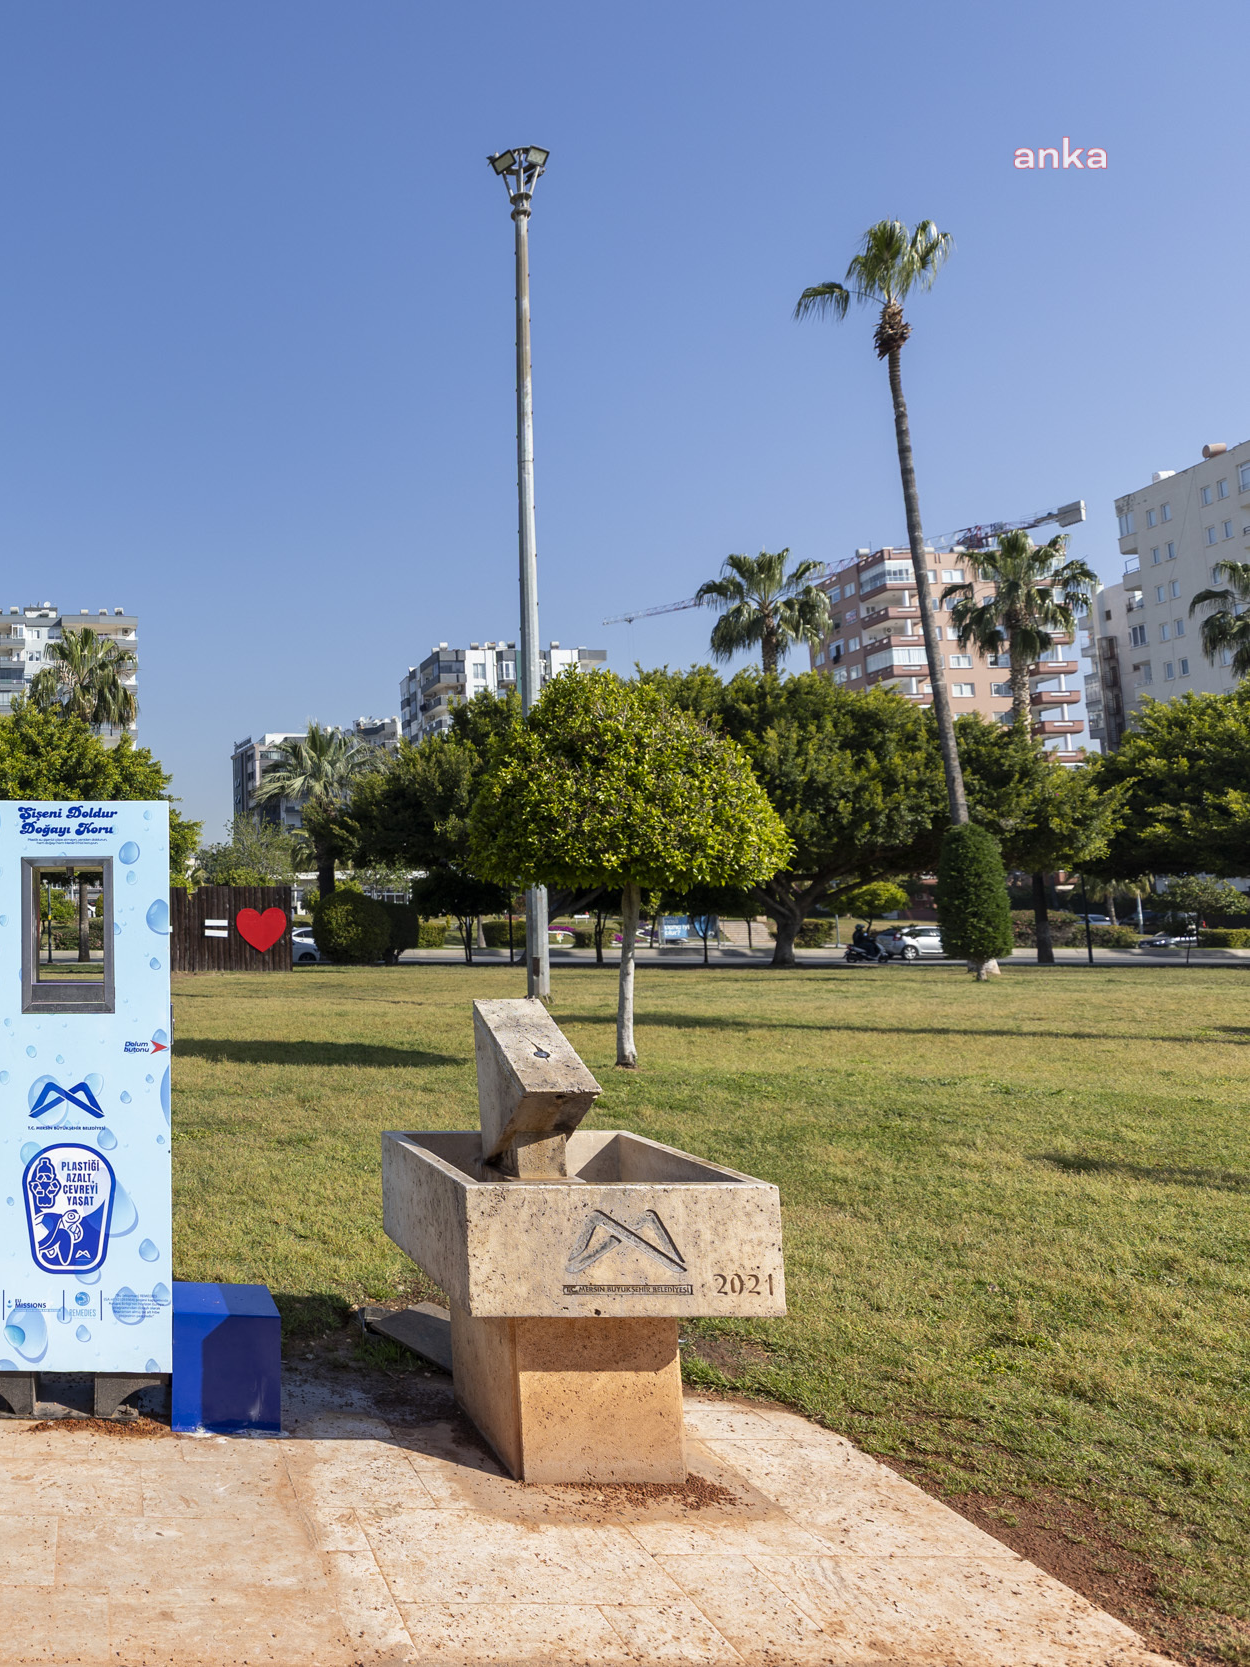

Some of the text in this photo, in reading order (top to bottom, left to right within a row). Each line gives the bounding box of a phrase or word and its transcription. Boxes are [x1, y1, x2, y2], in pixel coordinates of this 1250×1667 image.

[18, 805, 118, 822] Şişeni Doldur
[20, 821, 114, 837] Doğayı Koru
[61, 1160, 100, 1171] PLASTİĞİ
[66, 1173, 95, 1184] AZALT,
[63, 1183, 98, 1195] ÇEVREYİ
[67, 1196, 94, 1206] YAŞAT
[713, 1273, 774, 1296] 2021
[69, 1309, 97, 1317] REMEDIES
